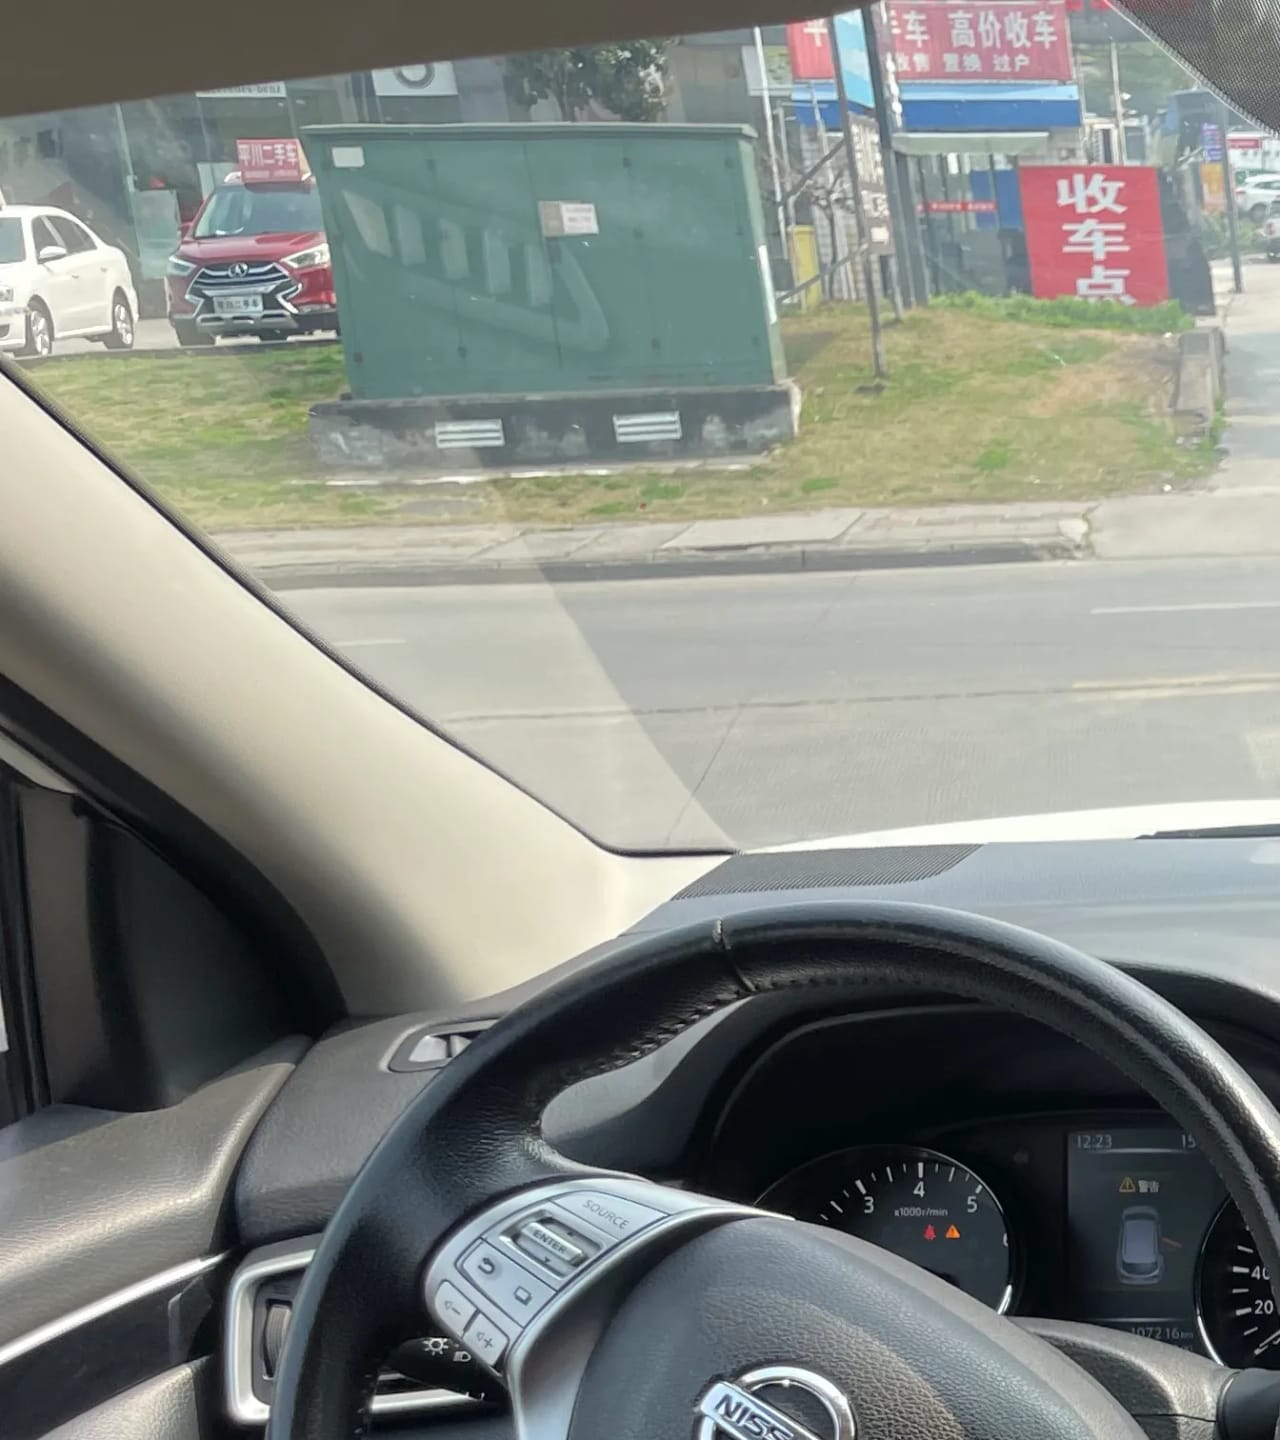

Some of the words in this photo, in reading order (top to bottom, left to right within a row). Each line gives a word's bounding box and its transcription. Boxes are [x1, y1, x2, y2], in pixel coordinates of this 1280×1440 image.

[947, 10, 1058, 49] 高价收车
[993, 53, 1030, 72] 过户
[1056, 173, 1137, 306] 收车点
[1077, 1134, 1113, 1150] 12:23
[913, 1181, 925, 1198] 4
[864, 1196, 874, 1214] 3
[967, 1196, 978, 1213] 5
[582, 1199, 631, 1230] SOURCE
[532, 1229, 567, 1254] ENTER
[1254, 1301, 1274, 1315] 20
